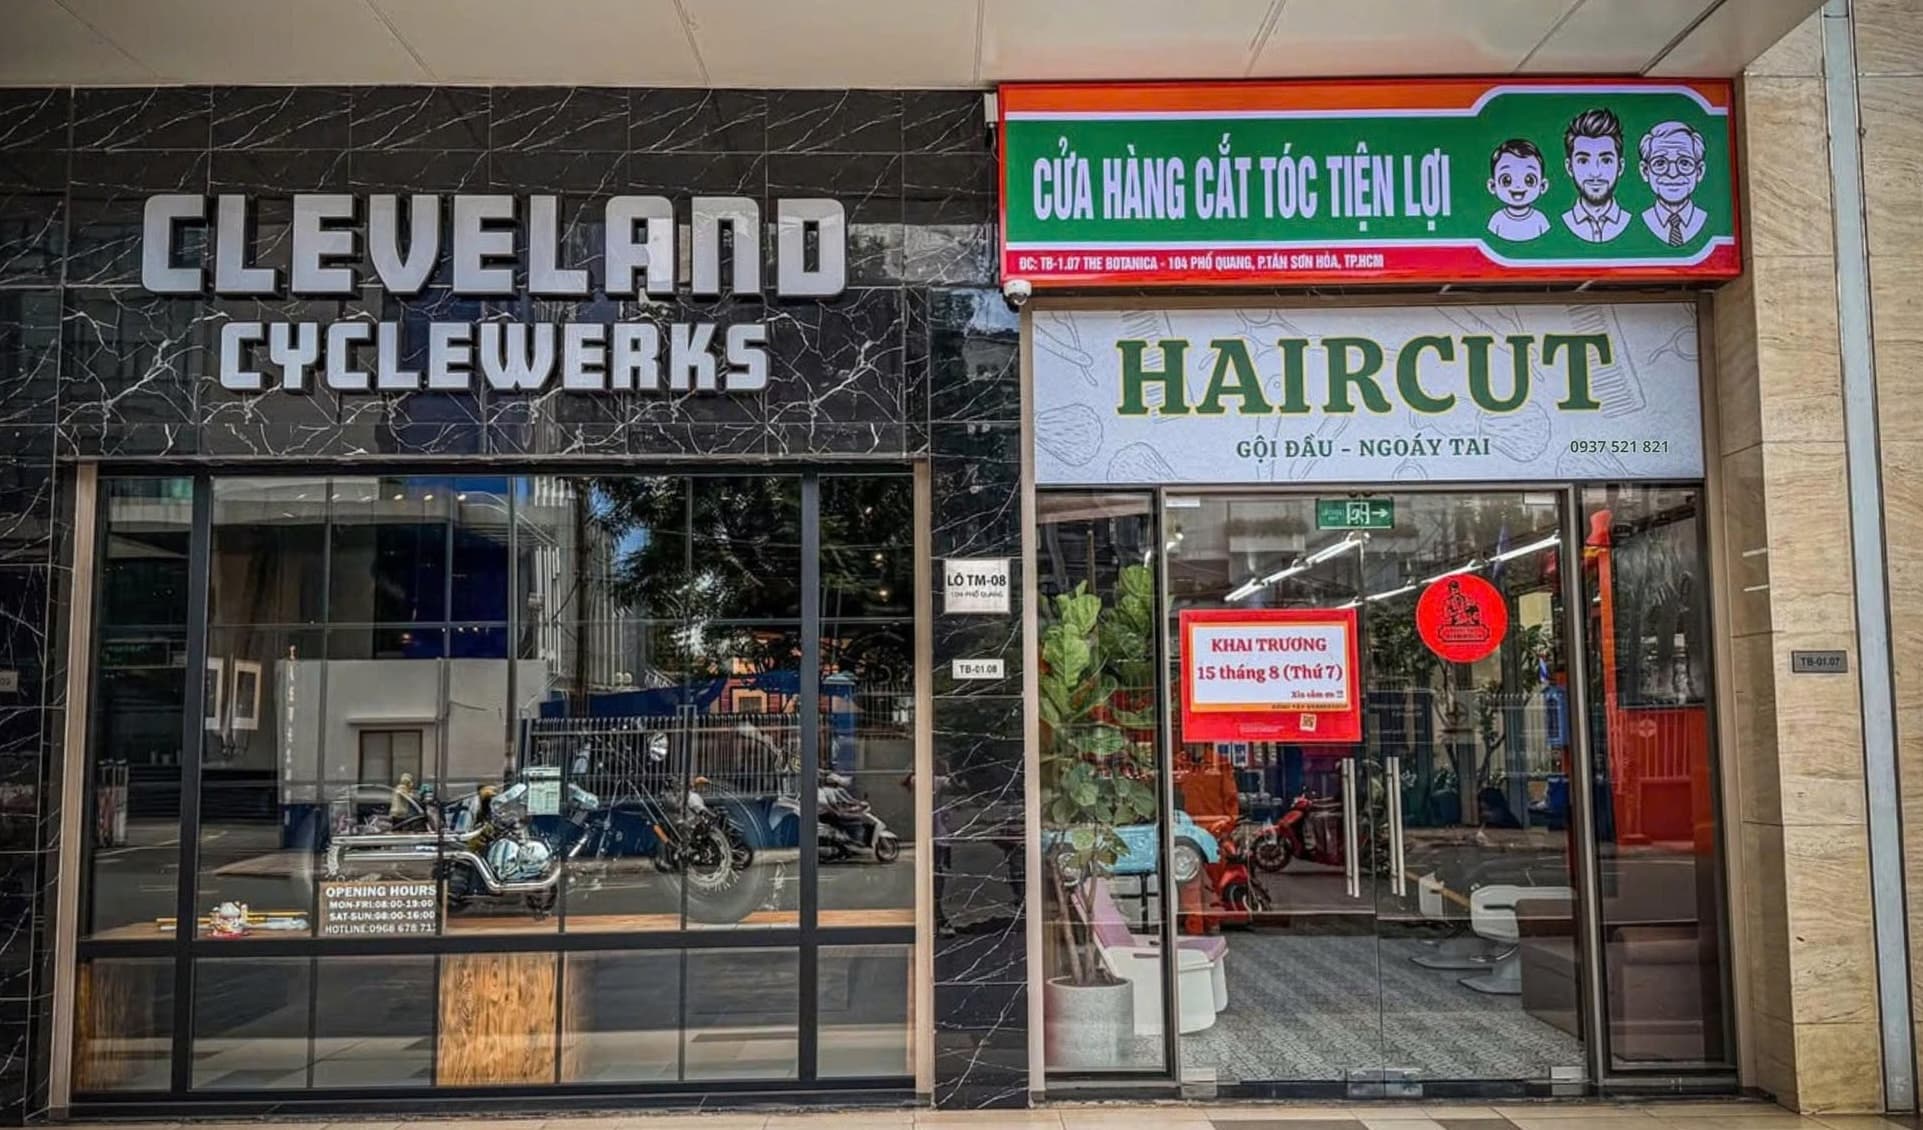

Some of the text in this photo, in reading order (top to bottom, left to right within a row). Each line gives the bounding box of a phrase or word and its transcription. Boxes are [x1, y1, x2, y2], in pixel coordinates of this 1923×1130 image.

[1033, 133, 1451, 232] CỬA HÀNG CẮT TÓC TIỆN LỢI
[142, 194, 847, 297] CLEVELAND
[1019, 256, 1038, 270] ĐC:
[1040, 256, 1080, 270] TB-1.07
[1083, 256, 1103, 270] THE
[1105, 256, 1158, 270] BOTANICA
[1168, 256, 1188, 270] 104
[1190, 251, 1213, 270] PHỐ
[1215, 255, 1255, 271] QUANG,
[1257, 252, 1287, 269] P.TÂN
[1290, 254, 1313, 269] SƠN
[1344, 254, 1384, 269] TP.HCM
[220, 322, 770, 391] CYCLEWERKS
[1115, 332, 1615, 416] HAIRCUT
[1236, 434, 1277, 463] GỘI
[1285, 433, 1332, 458] ĐẦU
[1359, 432, 1441, 457] NGOÁY
[1448, 438, 1490, 456] TAI
[1570, 440, 1668, 453] 0937 521 821
[947, 572, 1007, 587] LÔ TM-08
[1211, 636, 1327, 652] KHAI TRƯƠNG
[959, 665, 998, 675] TB-01.08
[1198, 663, 1343, 683] 15 tháng 8 (Thứ 7)
[325, 884, 437, 898] OPENING HOURS
